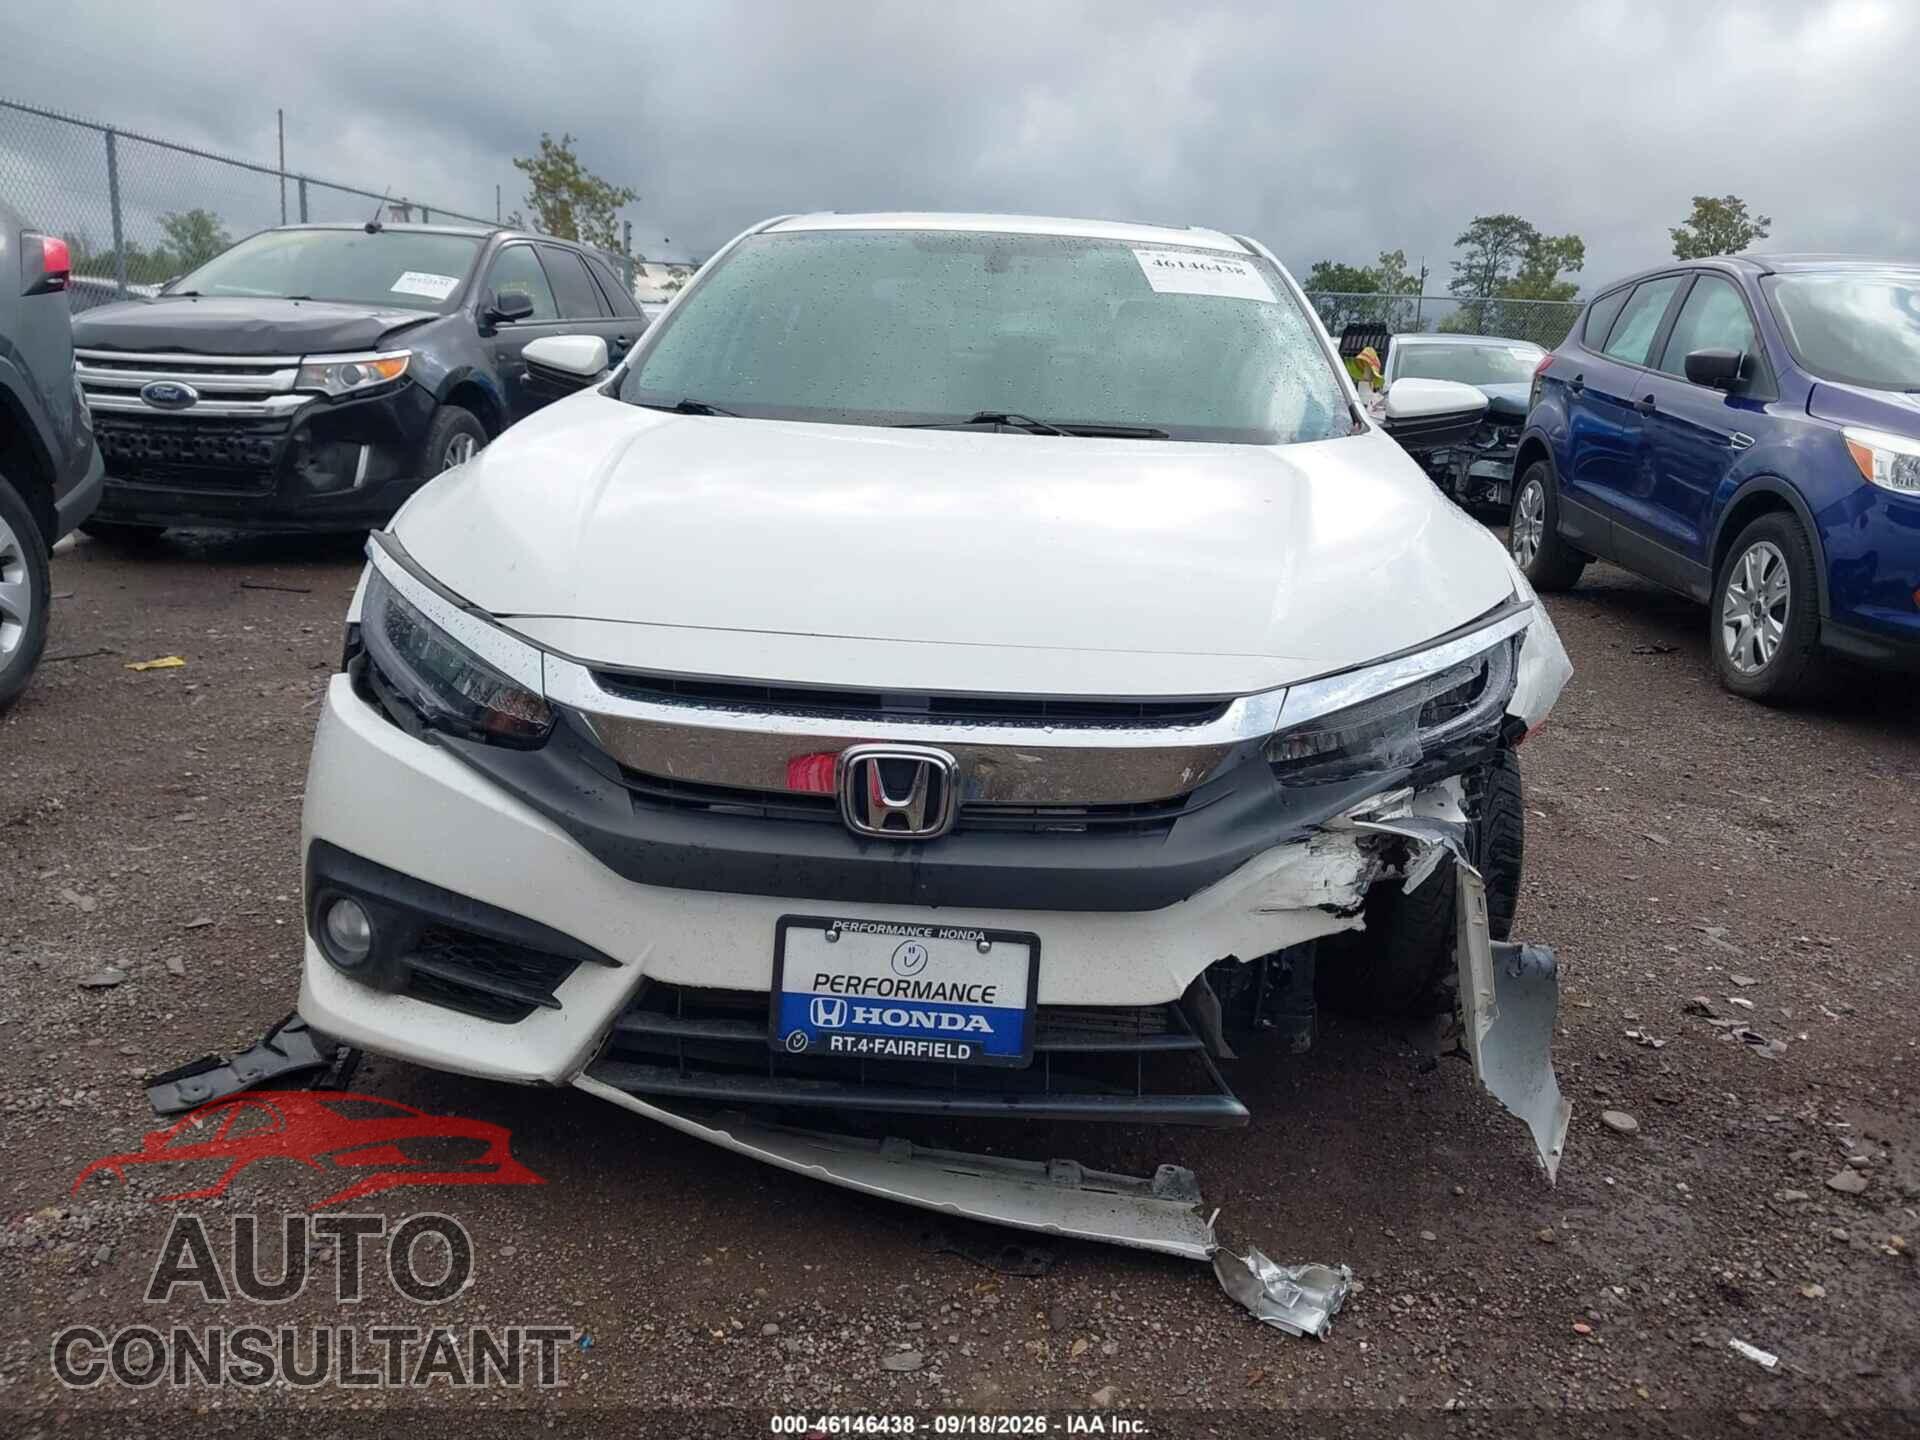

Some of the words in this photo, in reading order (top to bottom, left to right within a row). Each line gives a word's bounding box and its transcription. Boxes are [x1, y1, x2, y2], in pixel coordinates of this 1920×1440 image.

[833, 920, 933, 937] PERFORMANCE
[938, 928, 986, 941] HONDA
[812, 973, 997, 1004] PERFORMANCE
[852, 1006, 994, 1033] HONDA
